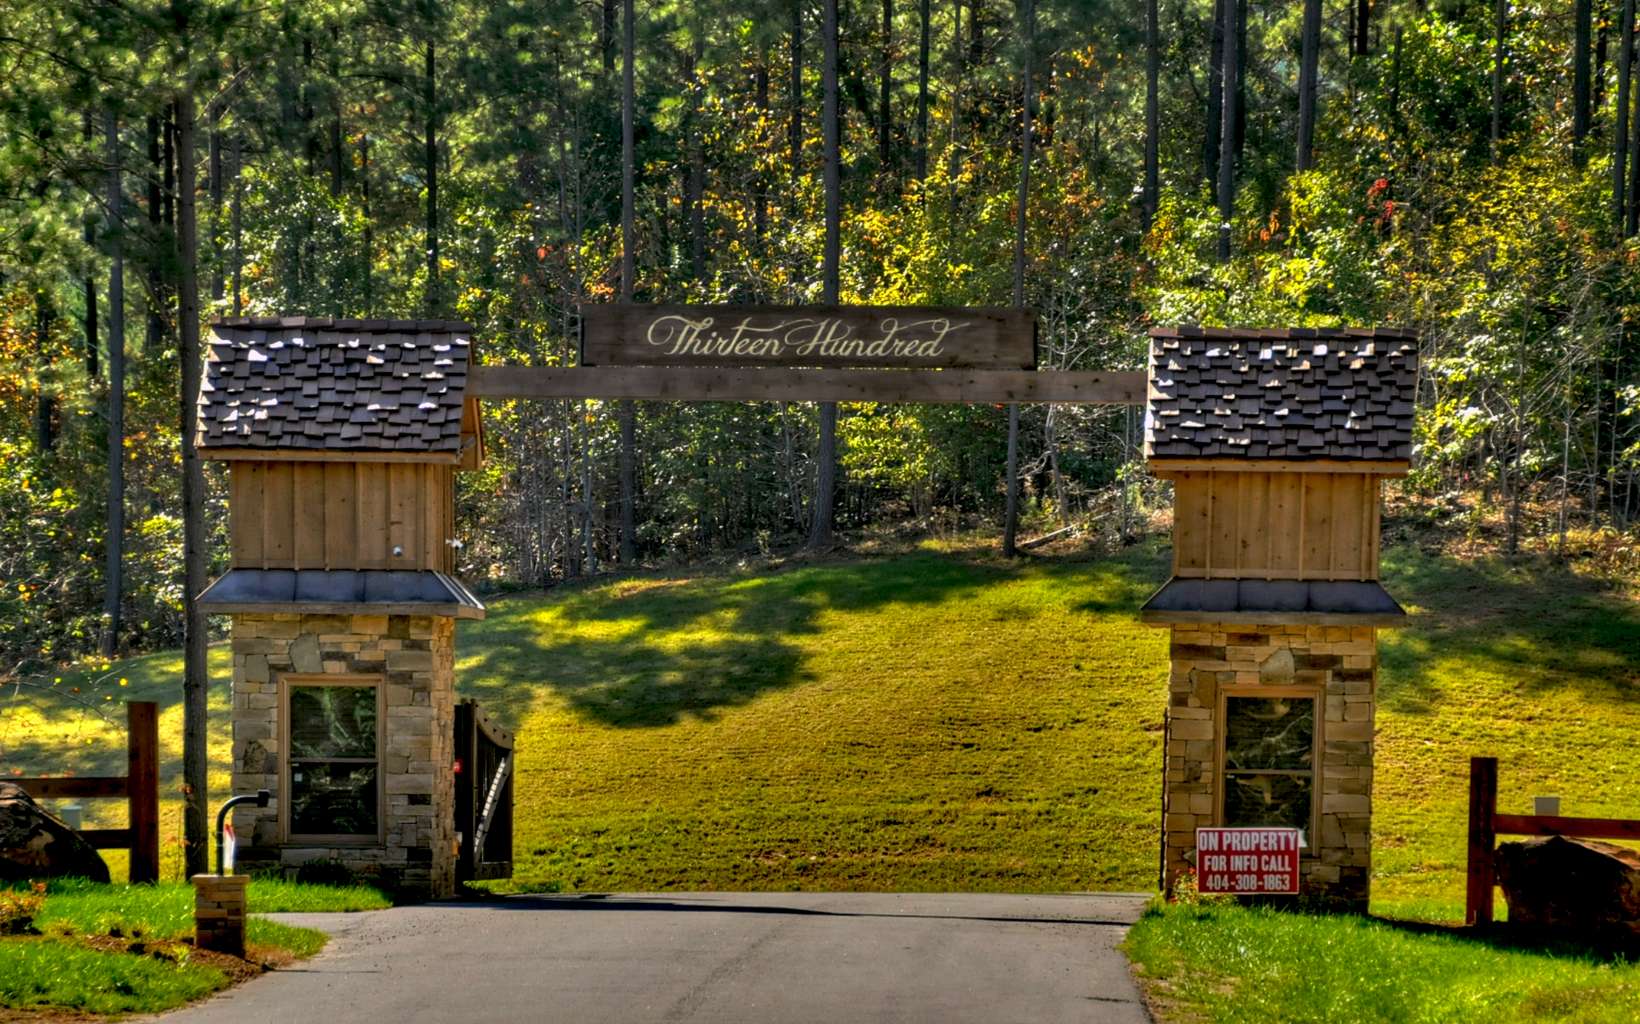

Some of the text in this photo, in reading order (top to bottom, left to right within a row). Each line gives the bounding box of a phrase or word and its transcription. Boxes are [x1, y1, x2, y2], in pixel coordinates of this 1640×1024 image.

[647, 315, 970, 356] Thirteen Hundred
[1200, 832, 1297, 851] ON PROPERTY
[1204, 855, 1292, 872] FOR INFO CALL
[1206, 874, 1290, 891] 404-308-1863
